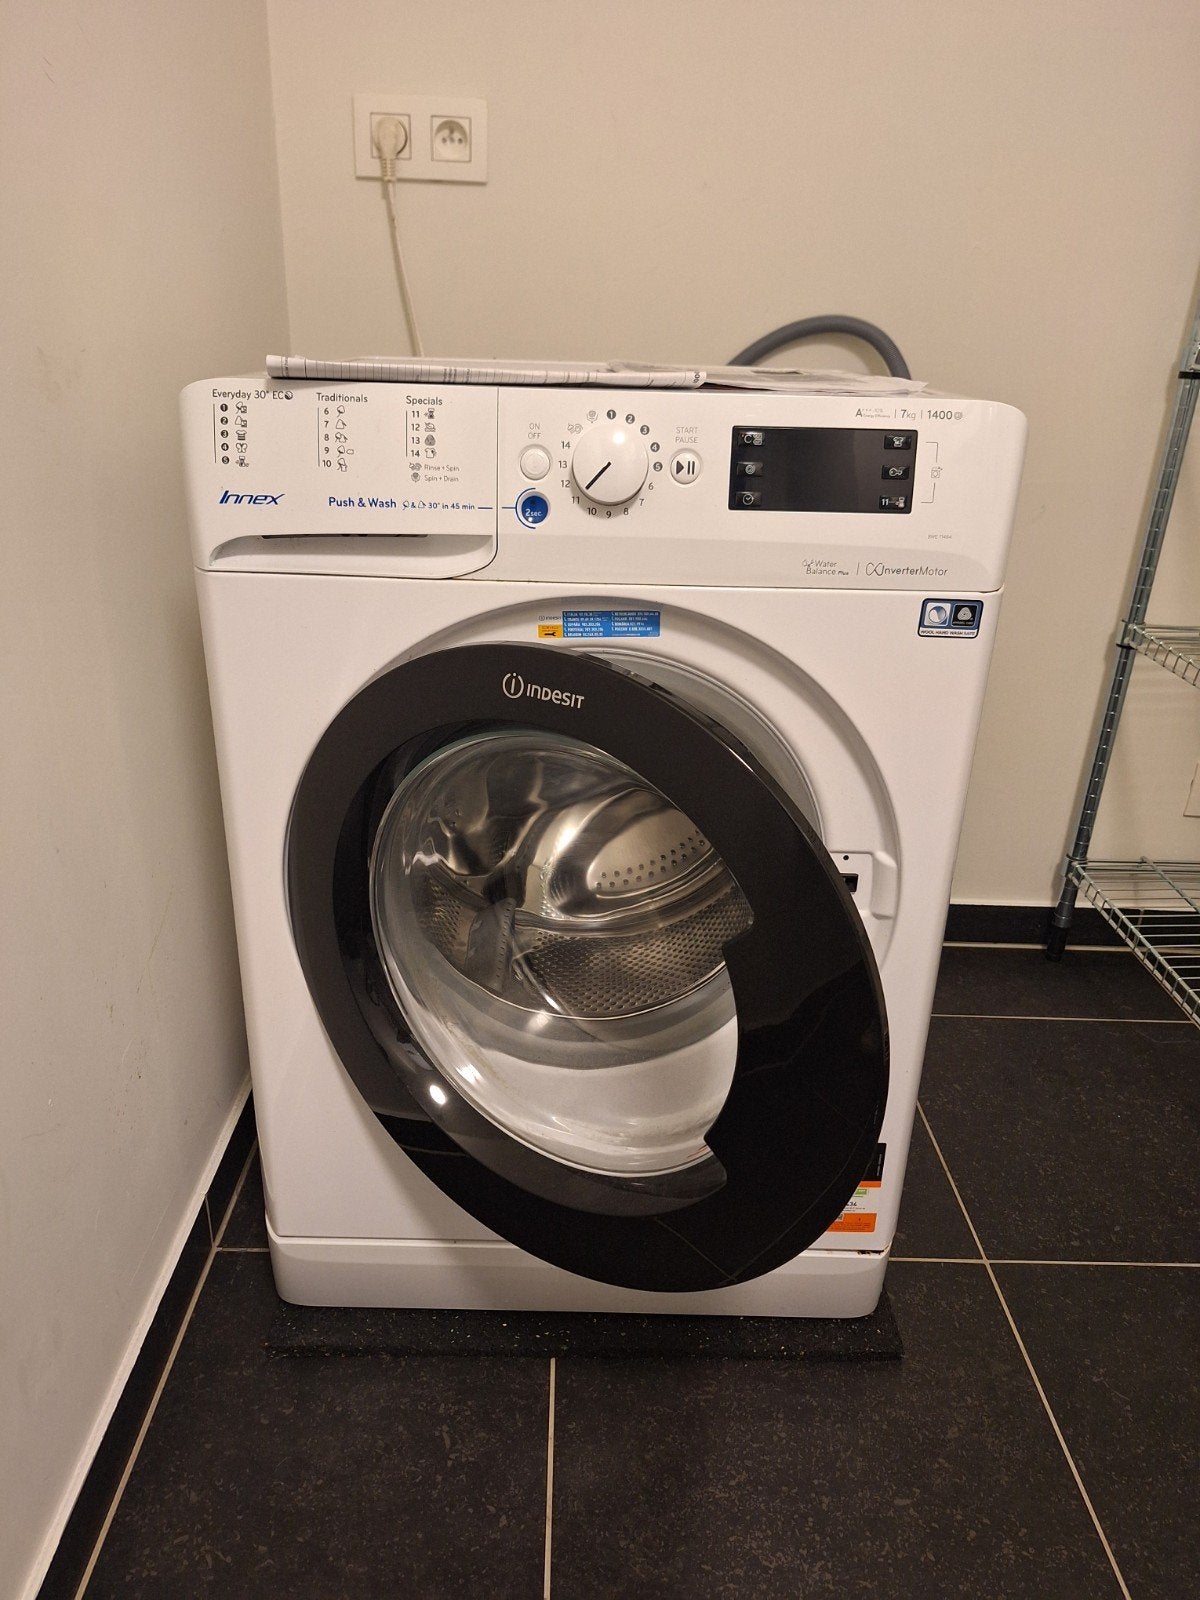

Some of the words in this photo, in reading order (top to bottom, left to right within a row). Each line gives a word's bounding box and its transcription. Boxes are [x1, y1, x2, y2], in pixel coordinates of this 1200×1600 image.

[212, 388, 251, 400] Everyday
[254, 389, 269, 399] 30°
[316, 392, 368, 403] Traditionals
[405, 395, 443, 406] Specials
[323, 407, 329, 415] 6
[411, 410, 420, 418] 11
[927, 409, 953, 420] 1400
[324, 420, 329, 428] 7
[411, 423, 420, 431] 12
[529, 422, 541, 430] ON
[675, 426, 698, 434] START
[323, 433, 329, 441] 8
[411, 436, 420, 444] 13
[527, 432, 541, 440] OFF
[675, 436, 699, 444] PAUSE
[561, 441, 571, 449] 14
[324, 446, 330, 454] 9
[410, 449, 420, 457] 14
[322, 459, 332, 467] 10
[558, 460, 567, 468] 13
[560, 480, 570, 488] 12
[648, 482, 654, 490] 6
[219, 490, 285, 505] Innex
[571, 496, 580, 504] 11
[328, 496, 355, 508] Push
[357, 497, 366, 508] &
[367, 497, 396, 508] Wash
[639, 498, 645, 506] 7
[587, 507, 597, 515] 10
[606, 510, 612, 518] 9
[623, 507, 629, 515] 8
[815, 560, 838, 568] Water
[806, 568, 837, 576] Balance
